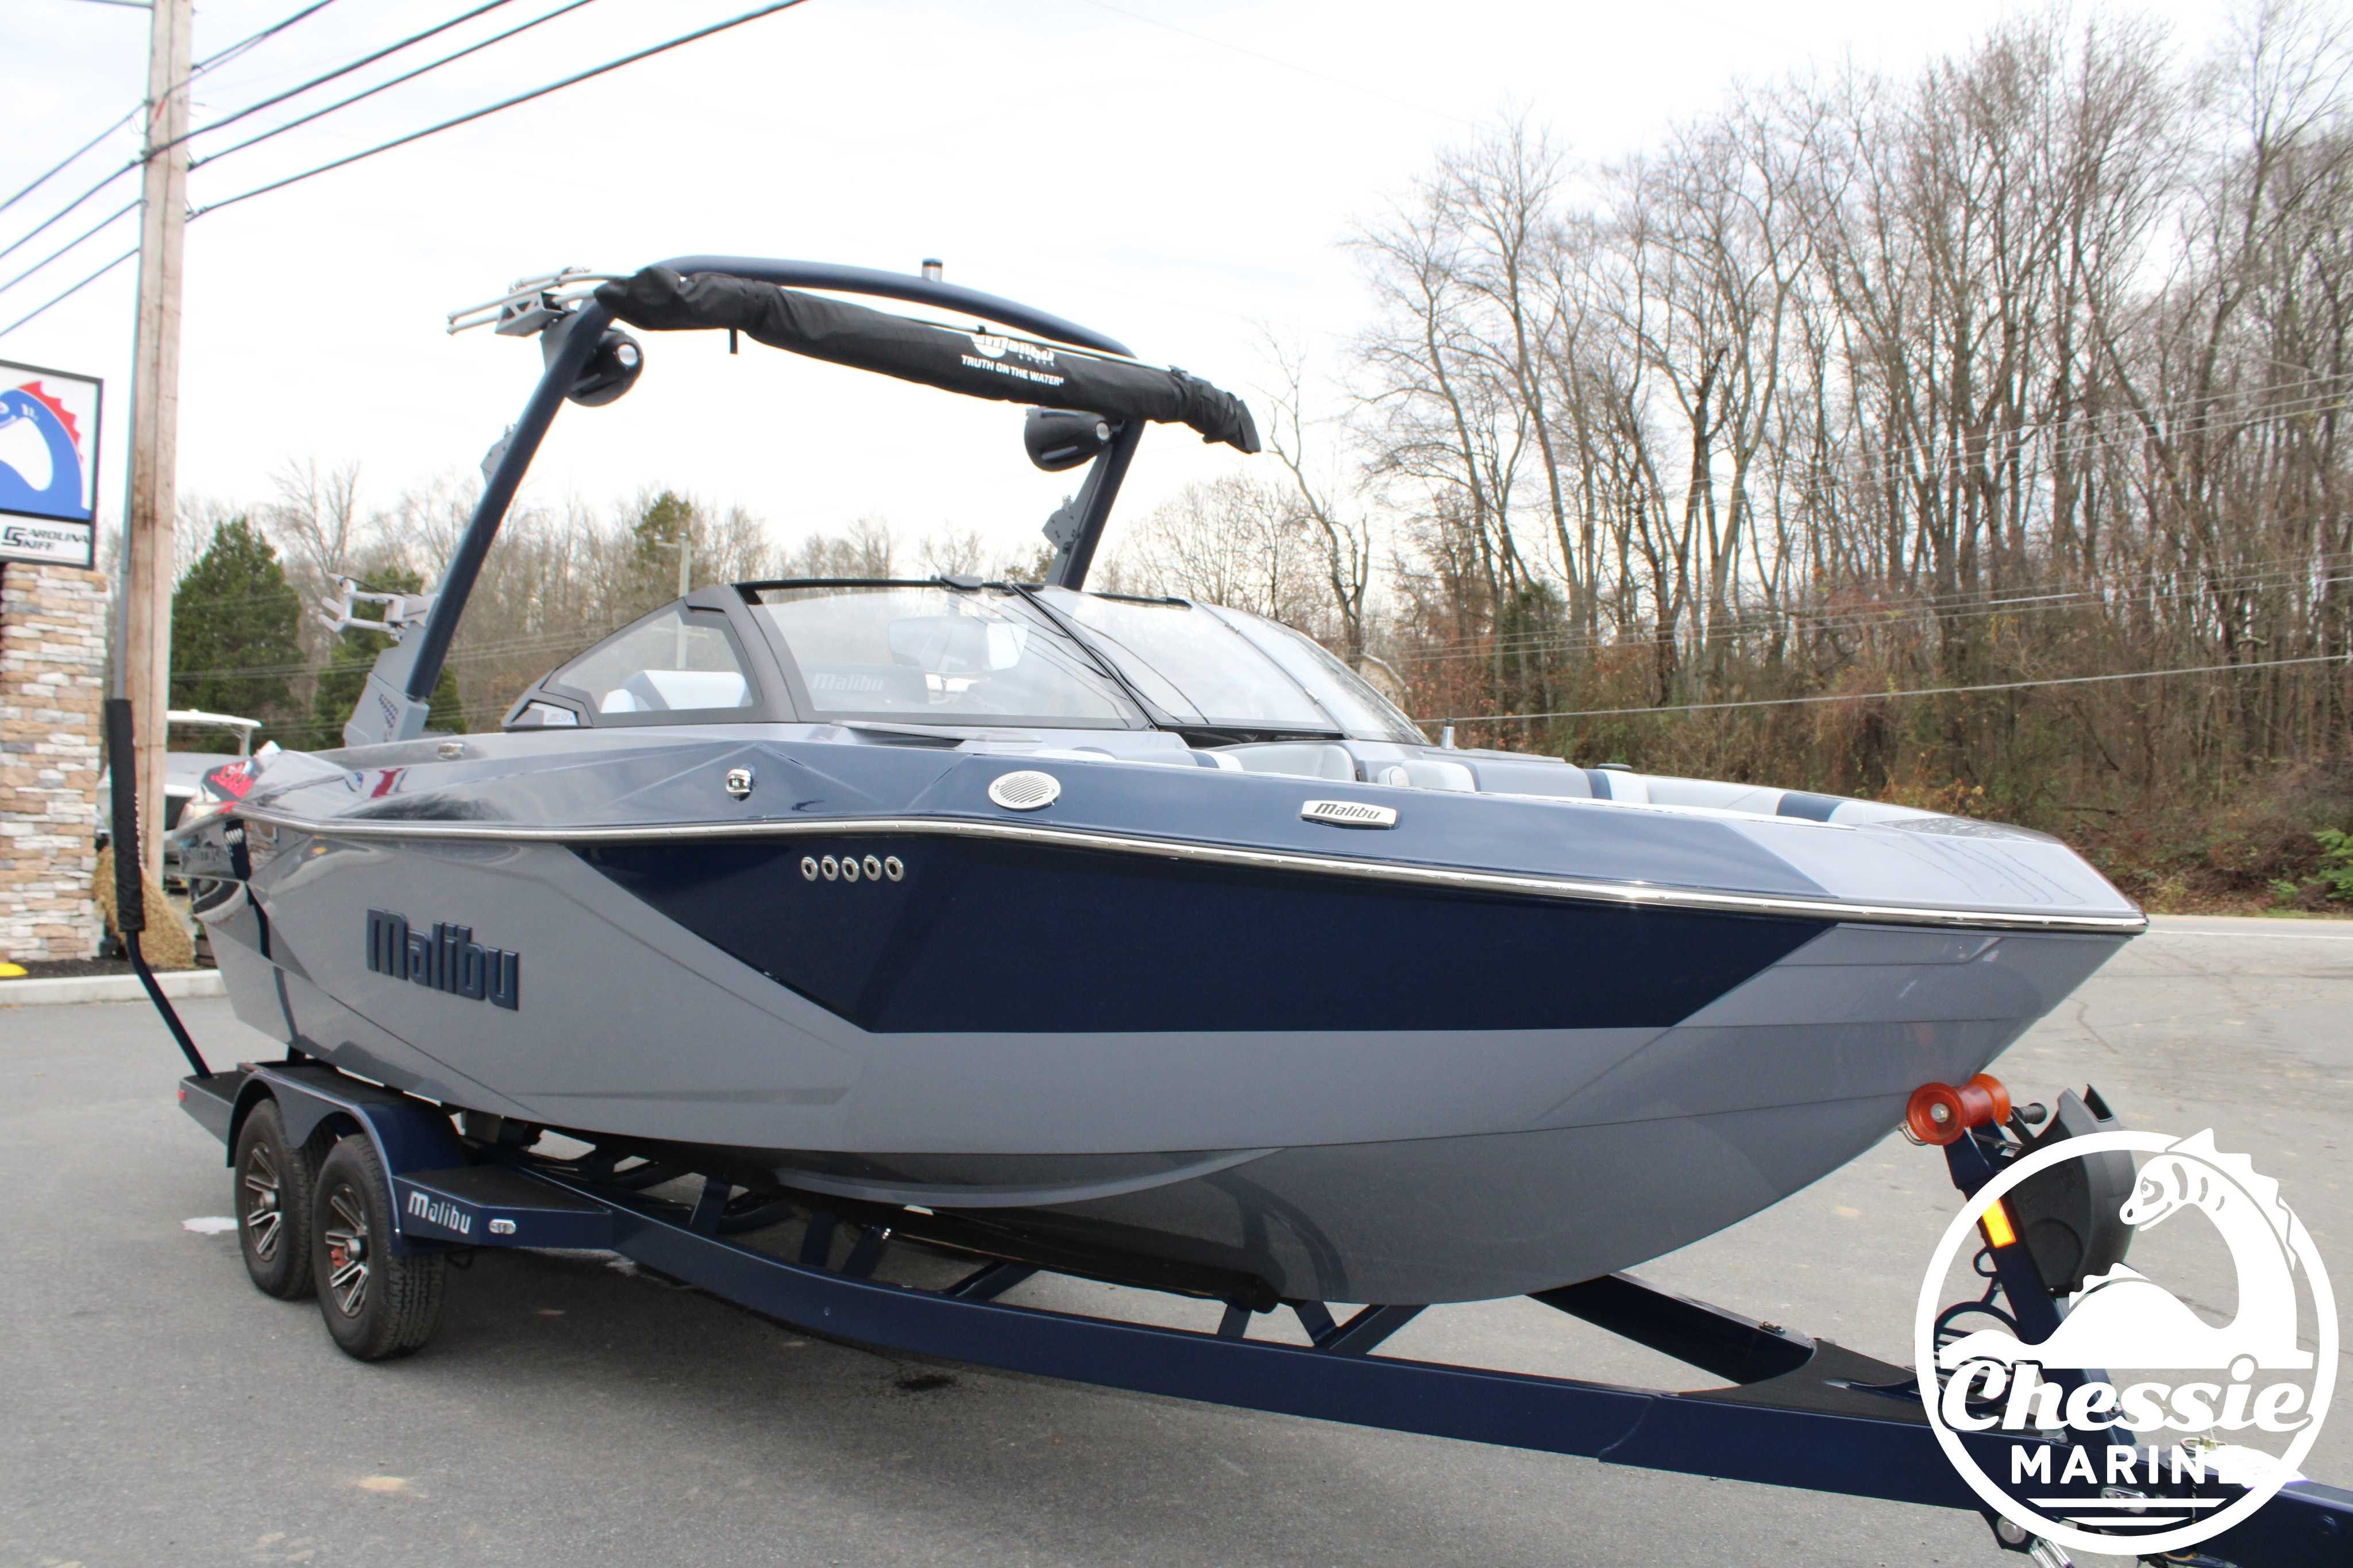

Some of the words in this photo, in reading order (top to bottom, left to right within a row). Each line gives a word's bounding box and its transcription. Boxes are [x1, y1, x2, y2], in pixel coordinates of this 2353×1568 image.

[961, 354, 994, 371] TRUTH
[996, 362, 1009, 374] ON
[1010, 366, 1029, 379] THE
[812, 673, 884, 692] Malibu
[1314, 803, 1381, 820] Malibu
[367, 906, 519, 1011] Malibu
[408, 1191, 472, 1234] Malibu
